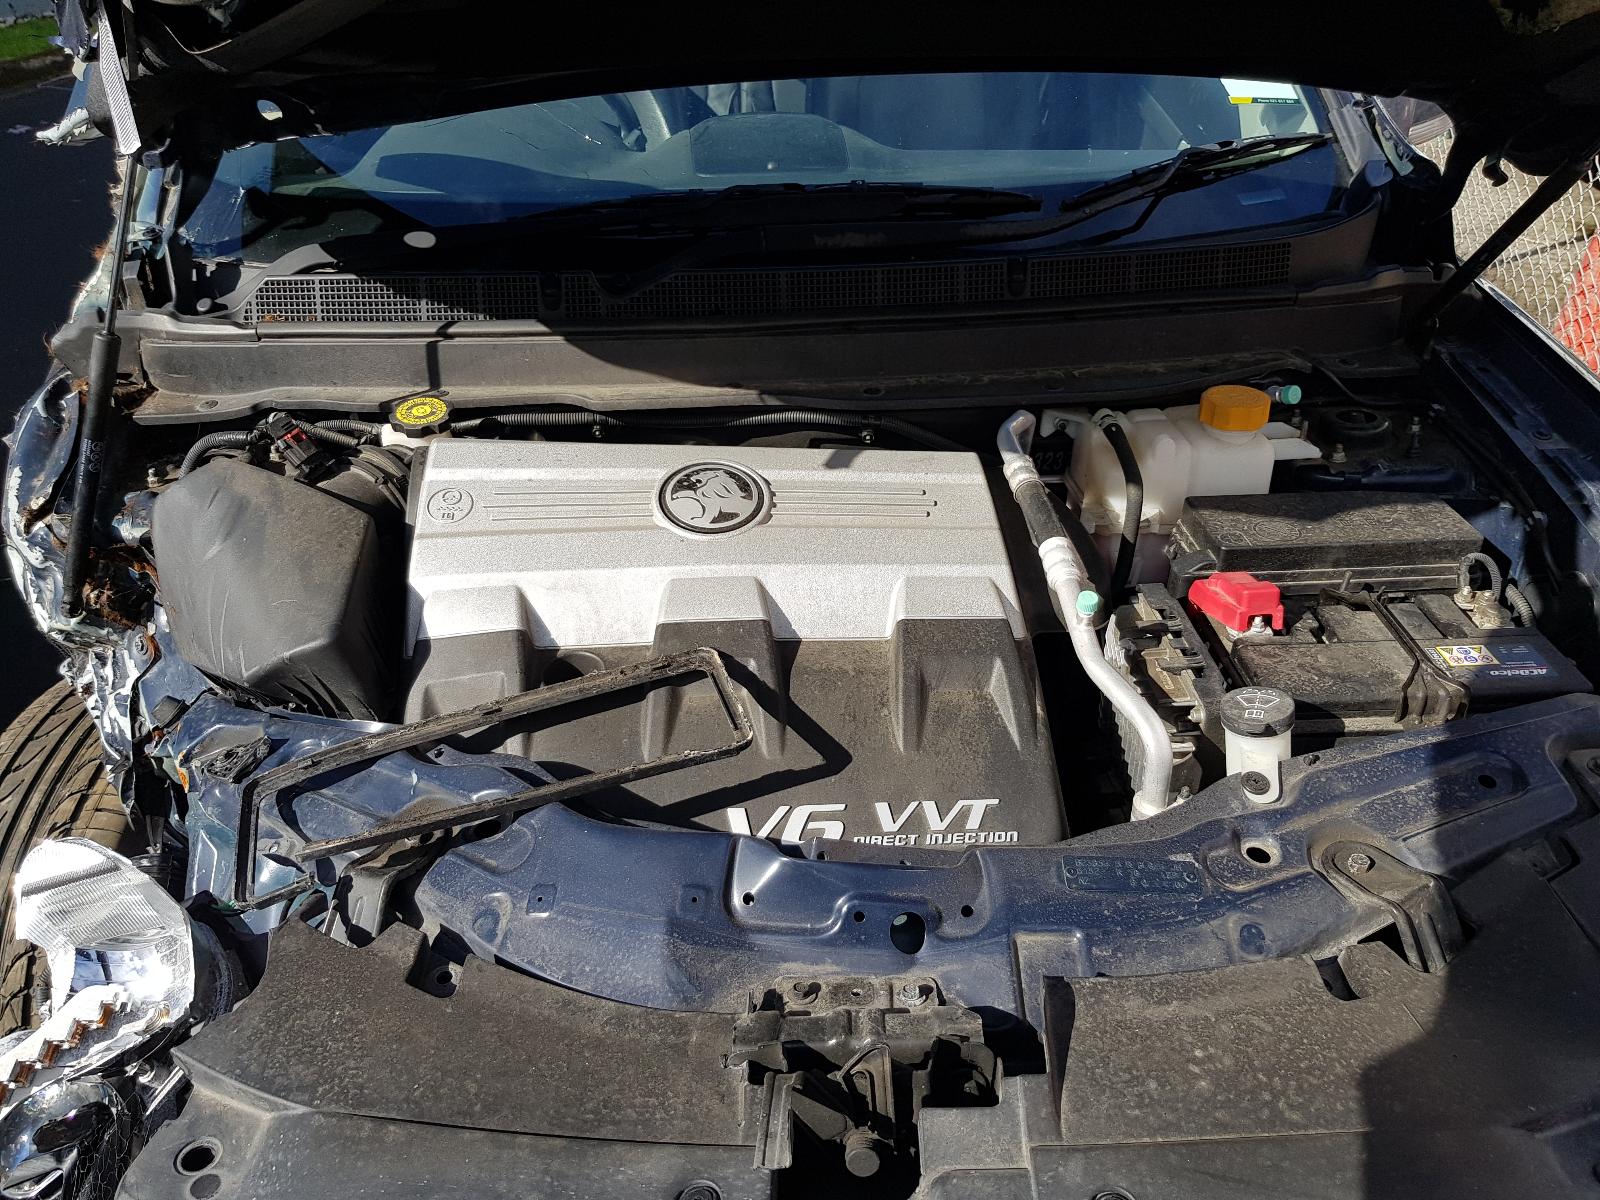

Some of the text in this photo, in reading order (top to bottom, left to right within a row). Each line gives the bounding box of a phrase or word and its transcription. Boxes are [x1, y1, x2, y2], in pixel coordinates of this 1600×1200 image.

[727, 799, 999, 845] V6 VVT
[853, 831, 1019, 846] DIRECT INJECTION
